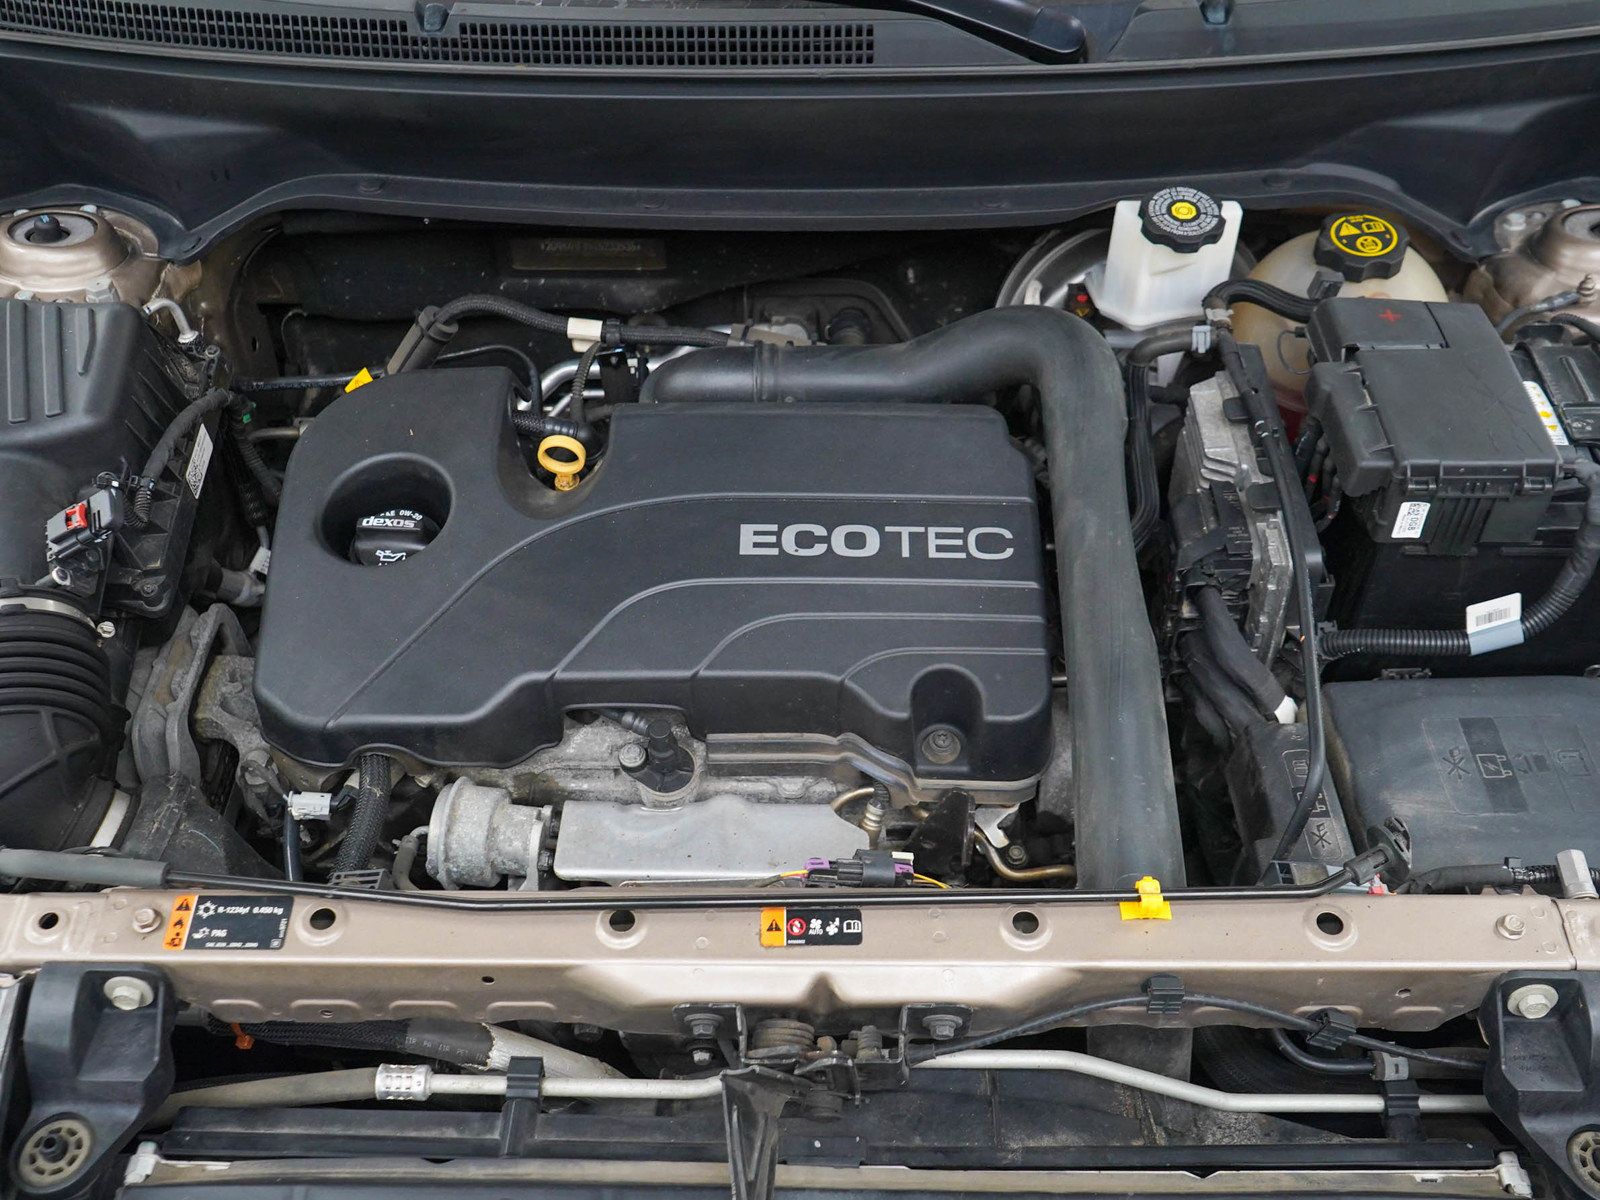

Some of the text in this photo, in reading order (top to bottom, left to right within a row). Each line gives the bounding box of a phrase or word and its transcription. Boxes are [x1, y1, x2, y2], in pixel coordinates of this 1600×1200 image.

[399, 509, 423, 521] 0W-20
[362, 516, 417, 528] dexos
[739, 523, 1014, 560] ECOTEC
